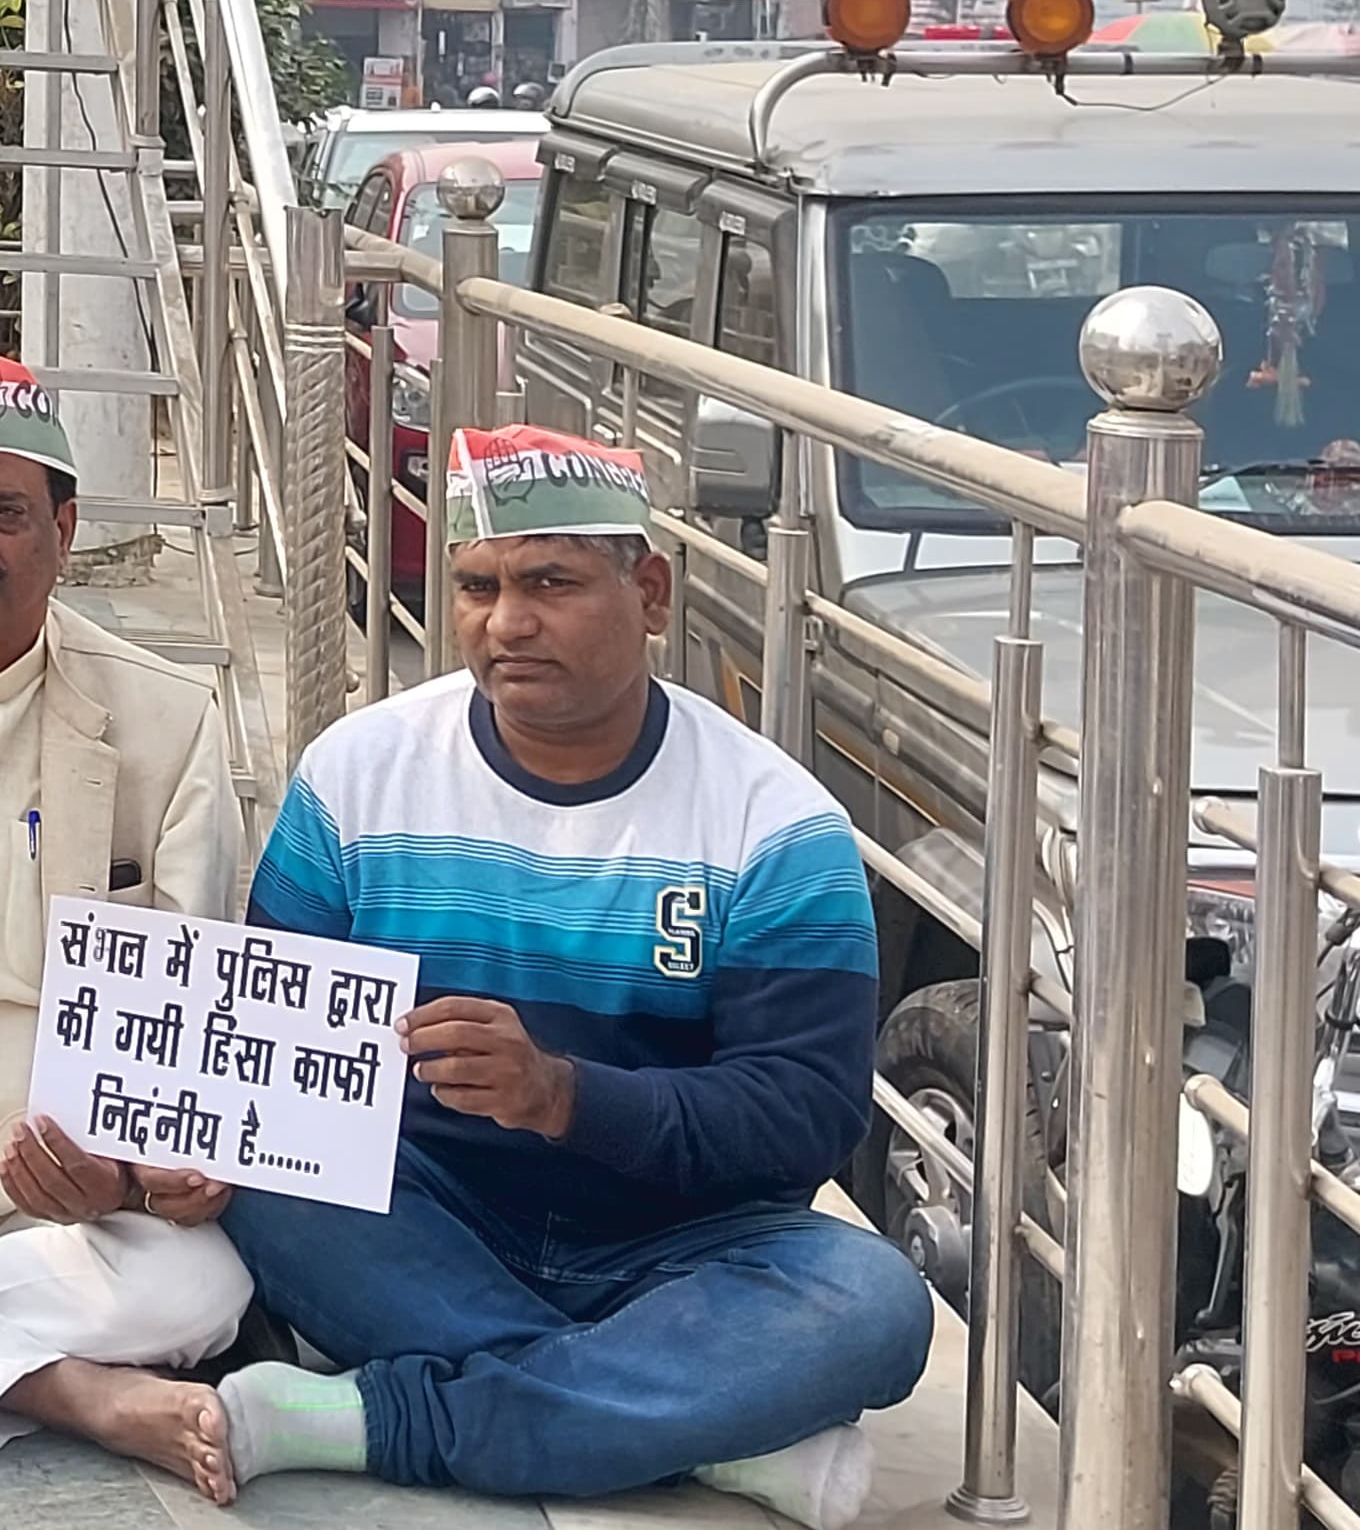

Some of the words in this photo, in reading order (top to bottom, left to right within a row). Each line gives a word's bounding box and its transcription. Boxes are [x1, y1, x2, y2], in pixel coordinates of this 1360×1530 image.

[59, 911, 149, 979] संभल
[164, 923, 200, 988] में
[215, 936, 313, 1013] पुलिस
[325, 968, 399, 1030] द्वारा
[653, 884, 706, 979] S
[55, 985, 98, 1052] की
[114, 1003, 185, 1069] गयी
[292, 1040, 382, 1109] काफी
